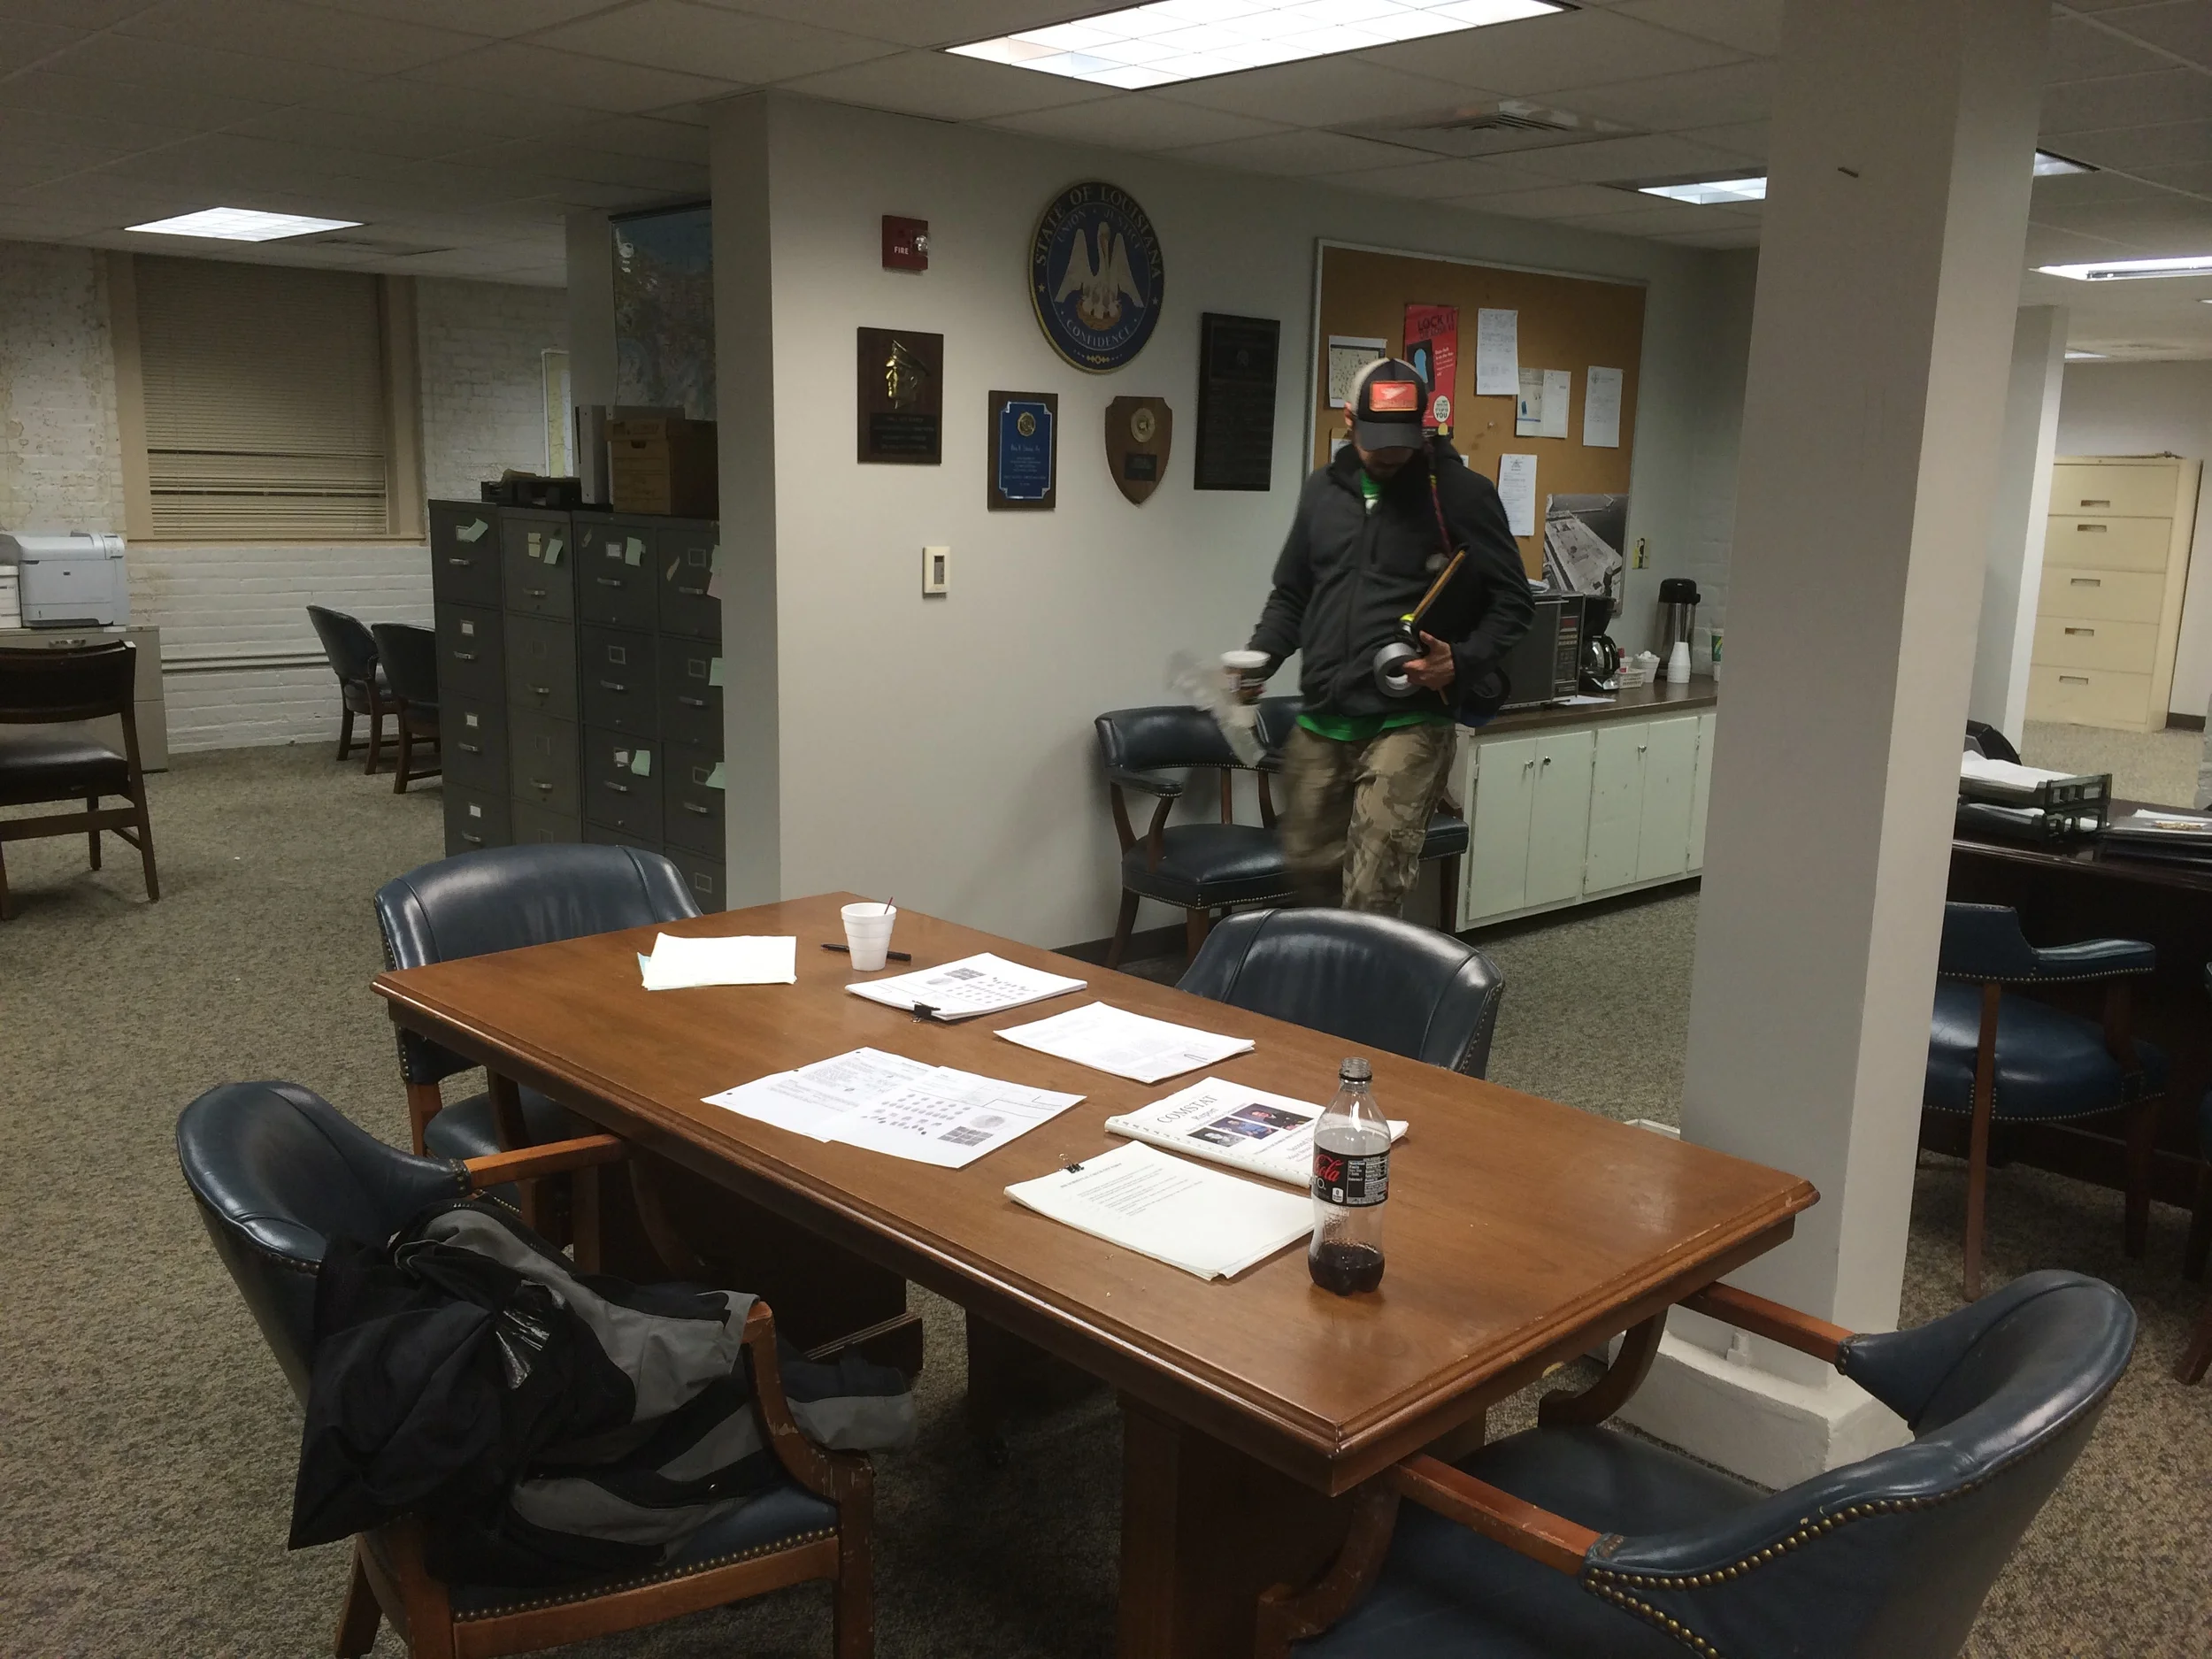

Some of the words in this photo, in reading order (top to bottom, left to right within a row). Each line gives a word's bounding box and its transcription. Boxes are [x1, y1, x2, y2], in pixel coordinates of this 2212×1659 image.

[1034, 203, 1067, 267] STATE
[1069, 186, 1094, 206] OF
[1100, 185, 1163, 280] LOUISIANA
[1056, 208, 1087, 243] UNION
[894, 246, 910, 255] FIRE
[1065, 319, 1131, 349] CONFIDENCE
[1417, 314, 1443, 331] LOCK
[1156, 1094, 1218, 1124] COMSTAT
[1314, 1154, 1345, 1182] Cola
